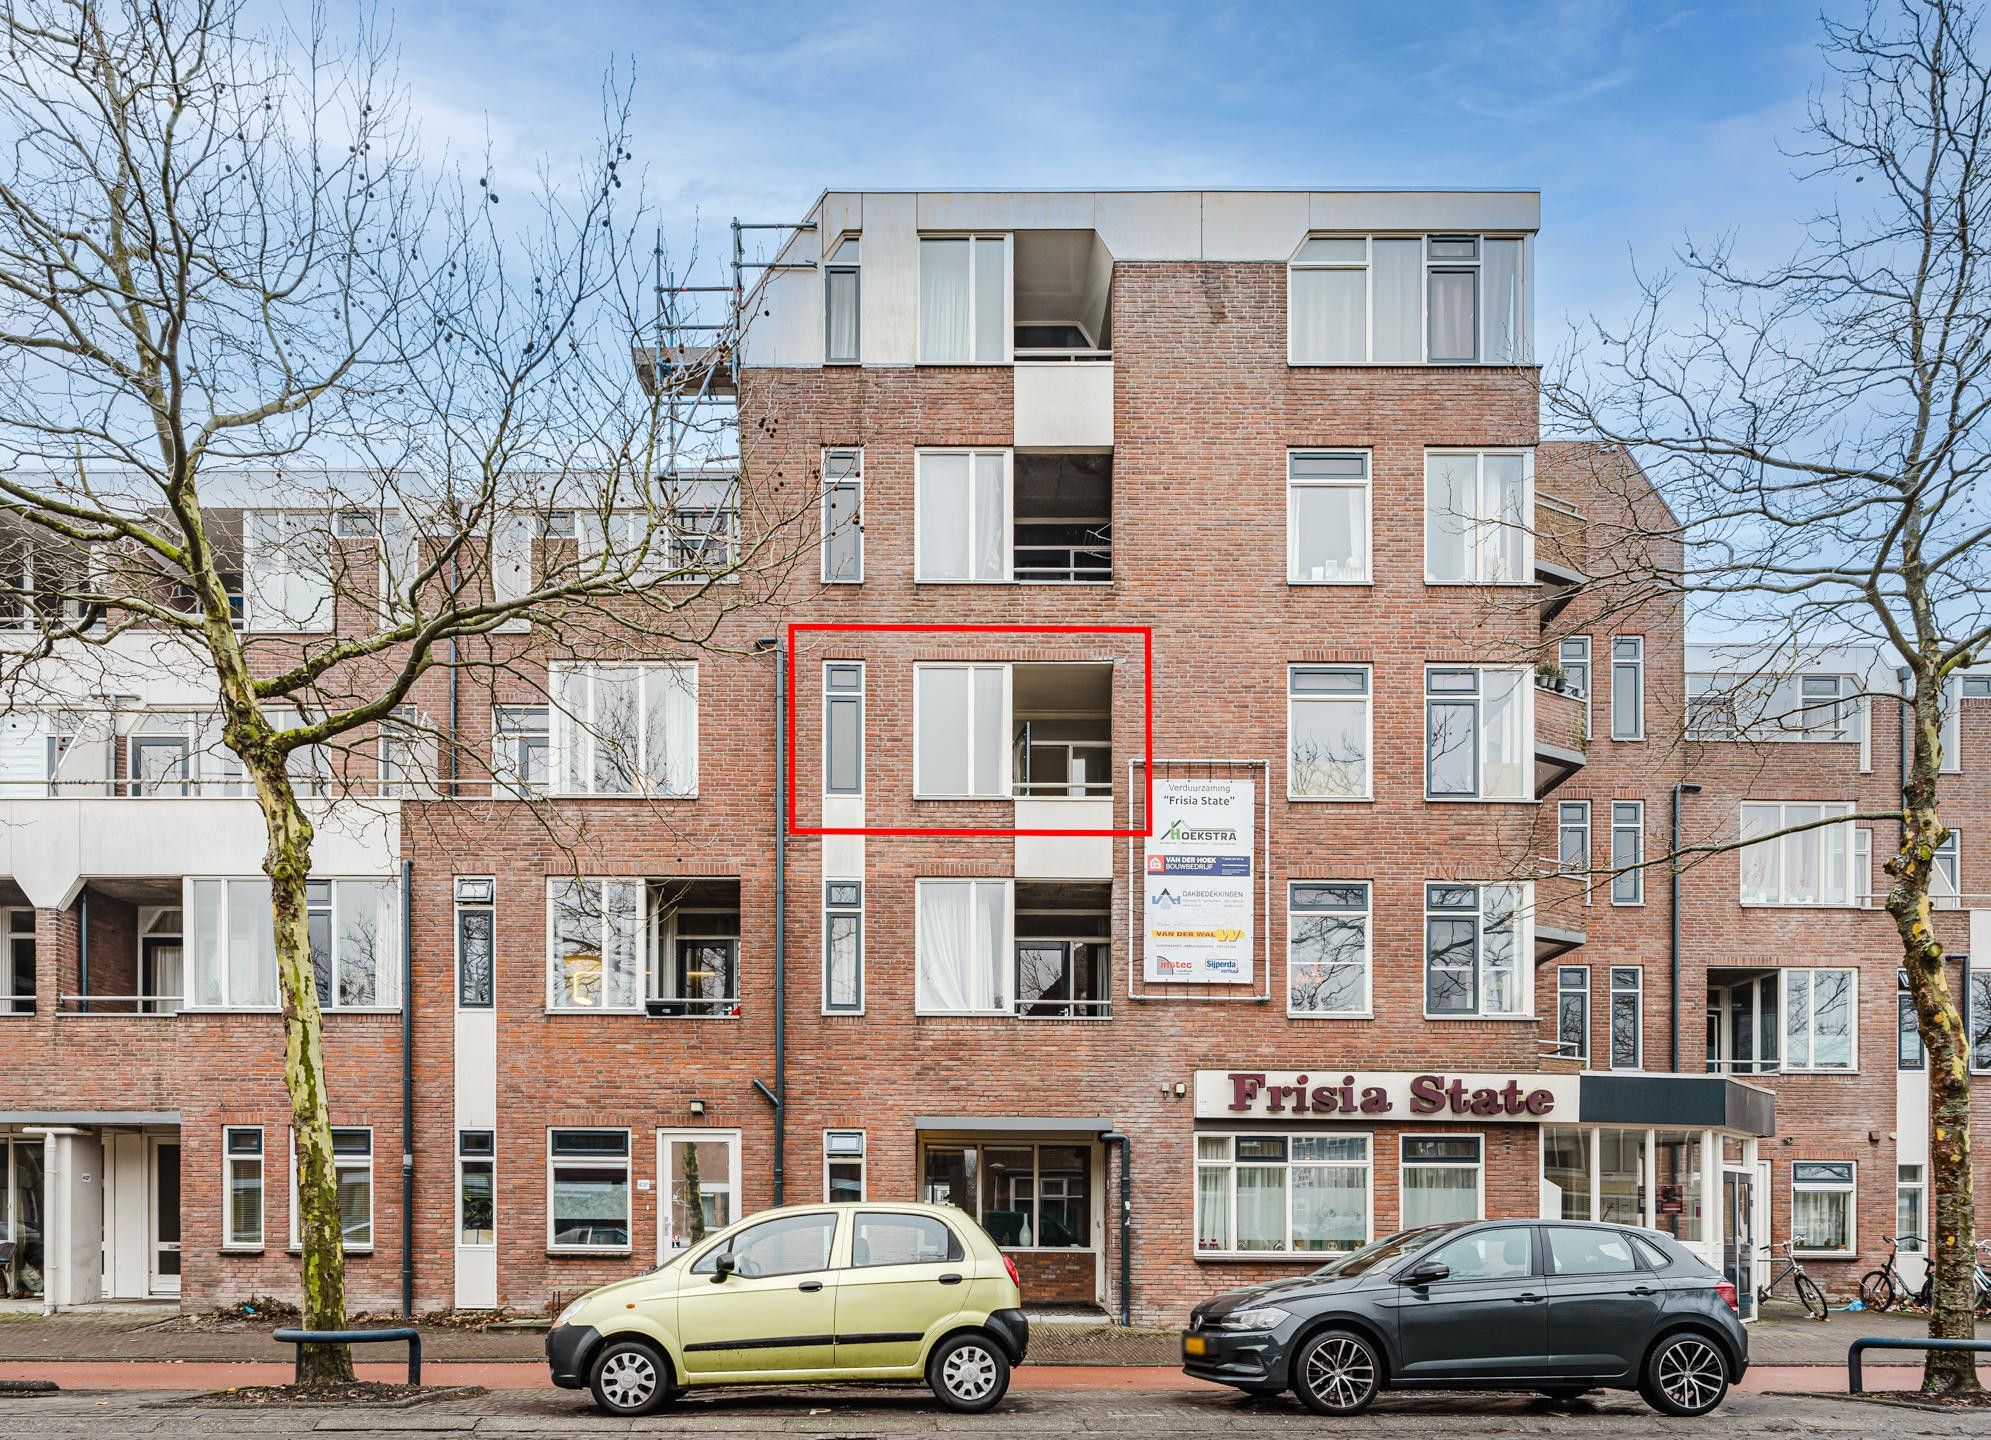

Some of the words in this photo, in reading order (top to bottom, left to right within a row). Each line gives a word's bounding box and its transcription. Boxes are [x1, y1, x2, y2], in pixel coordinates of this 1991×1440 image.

[1169, 784, 1231, 793] Verduurzaming
[1170, 828, 1237, 841] HOEKSTRA
[1182, 890, 1244, 898] DAKBEDEKKINGEN
[1206, 960, 1236, 969] Sijperda
[1227, 1073, 1393, 1113] Frisia
[1409, 1075, 1555, 1115] State
